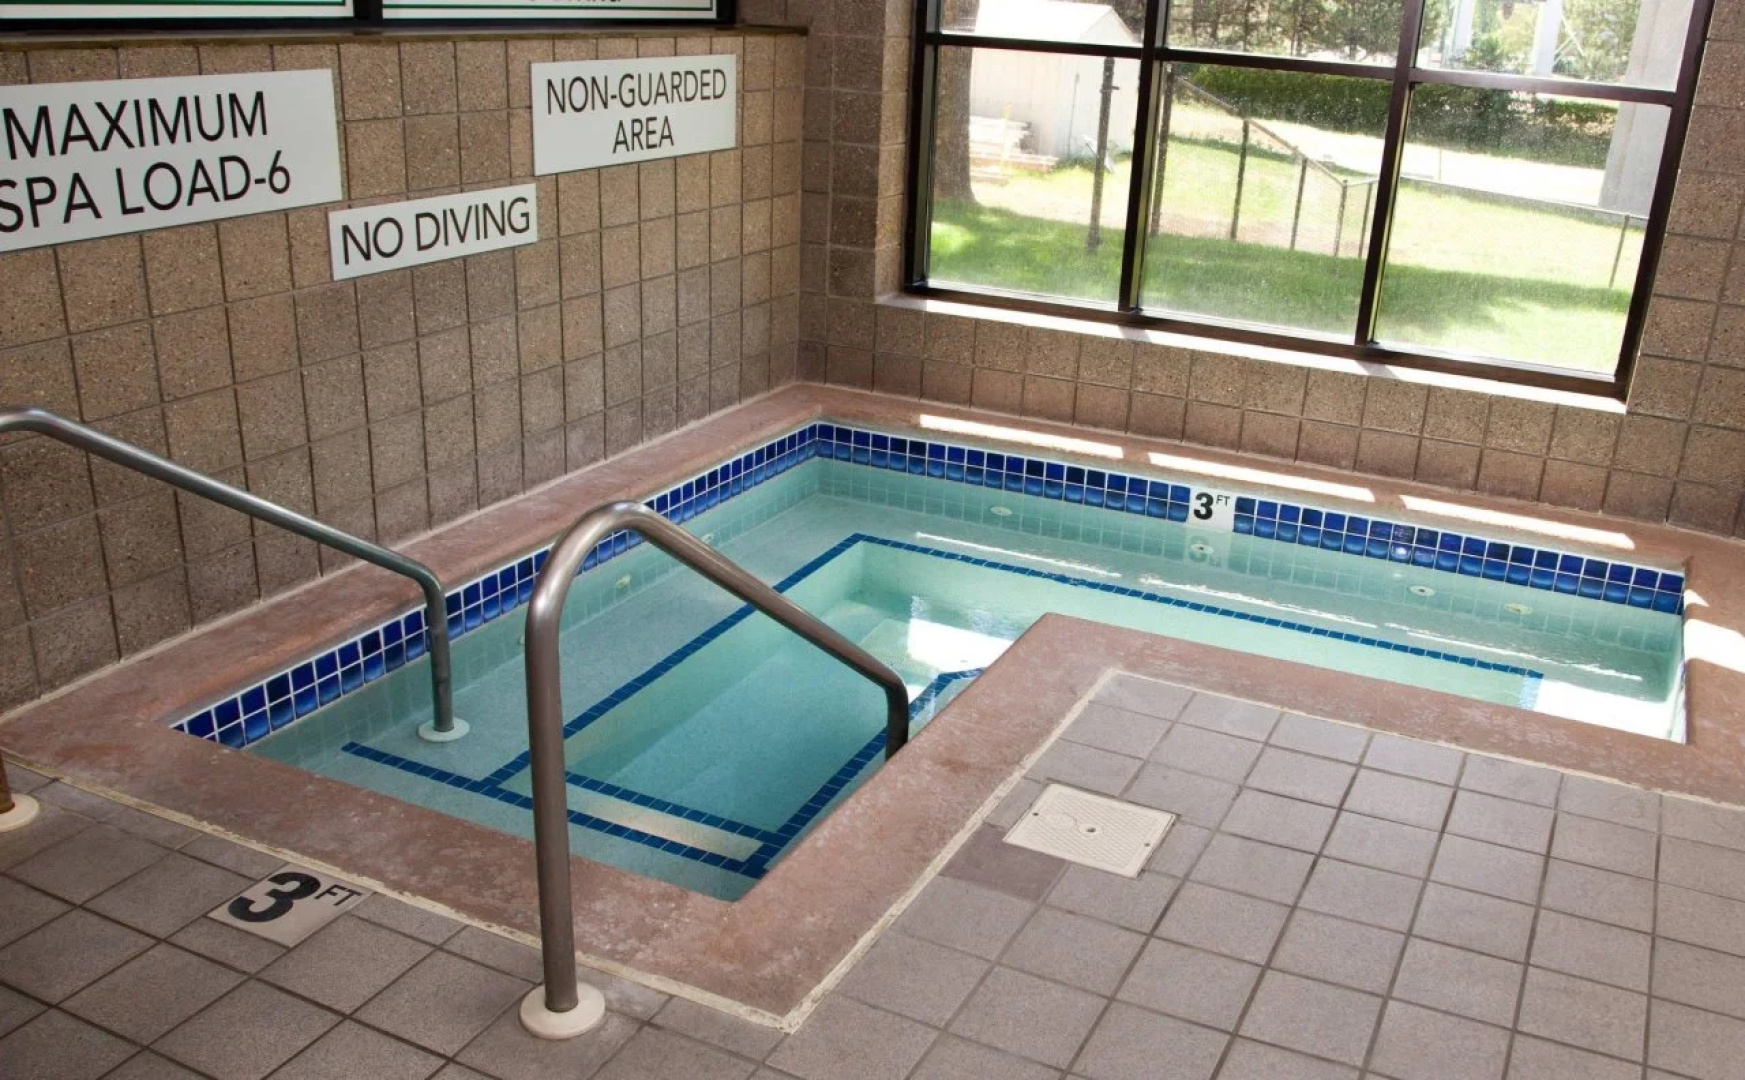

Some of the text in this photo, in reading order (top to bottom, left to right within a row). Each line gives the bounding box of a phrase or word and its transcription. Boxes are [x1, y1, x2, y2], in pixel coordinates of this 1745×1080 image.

[547, 68, 727, 115] NON-GUARDED
[2, 91, 268, 160] MAXIMUM
[612, 115, 675, 154] AREA
[0, 150, 291, 233] SPA LOAD-6
[341, 196, 531, 265] NO DIVING
[1194, 492, 1231, 520] 3 FT
[228, 872, 363, 923] 3 FT
